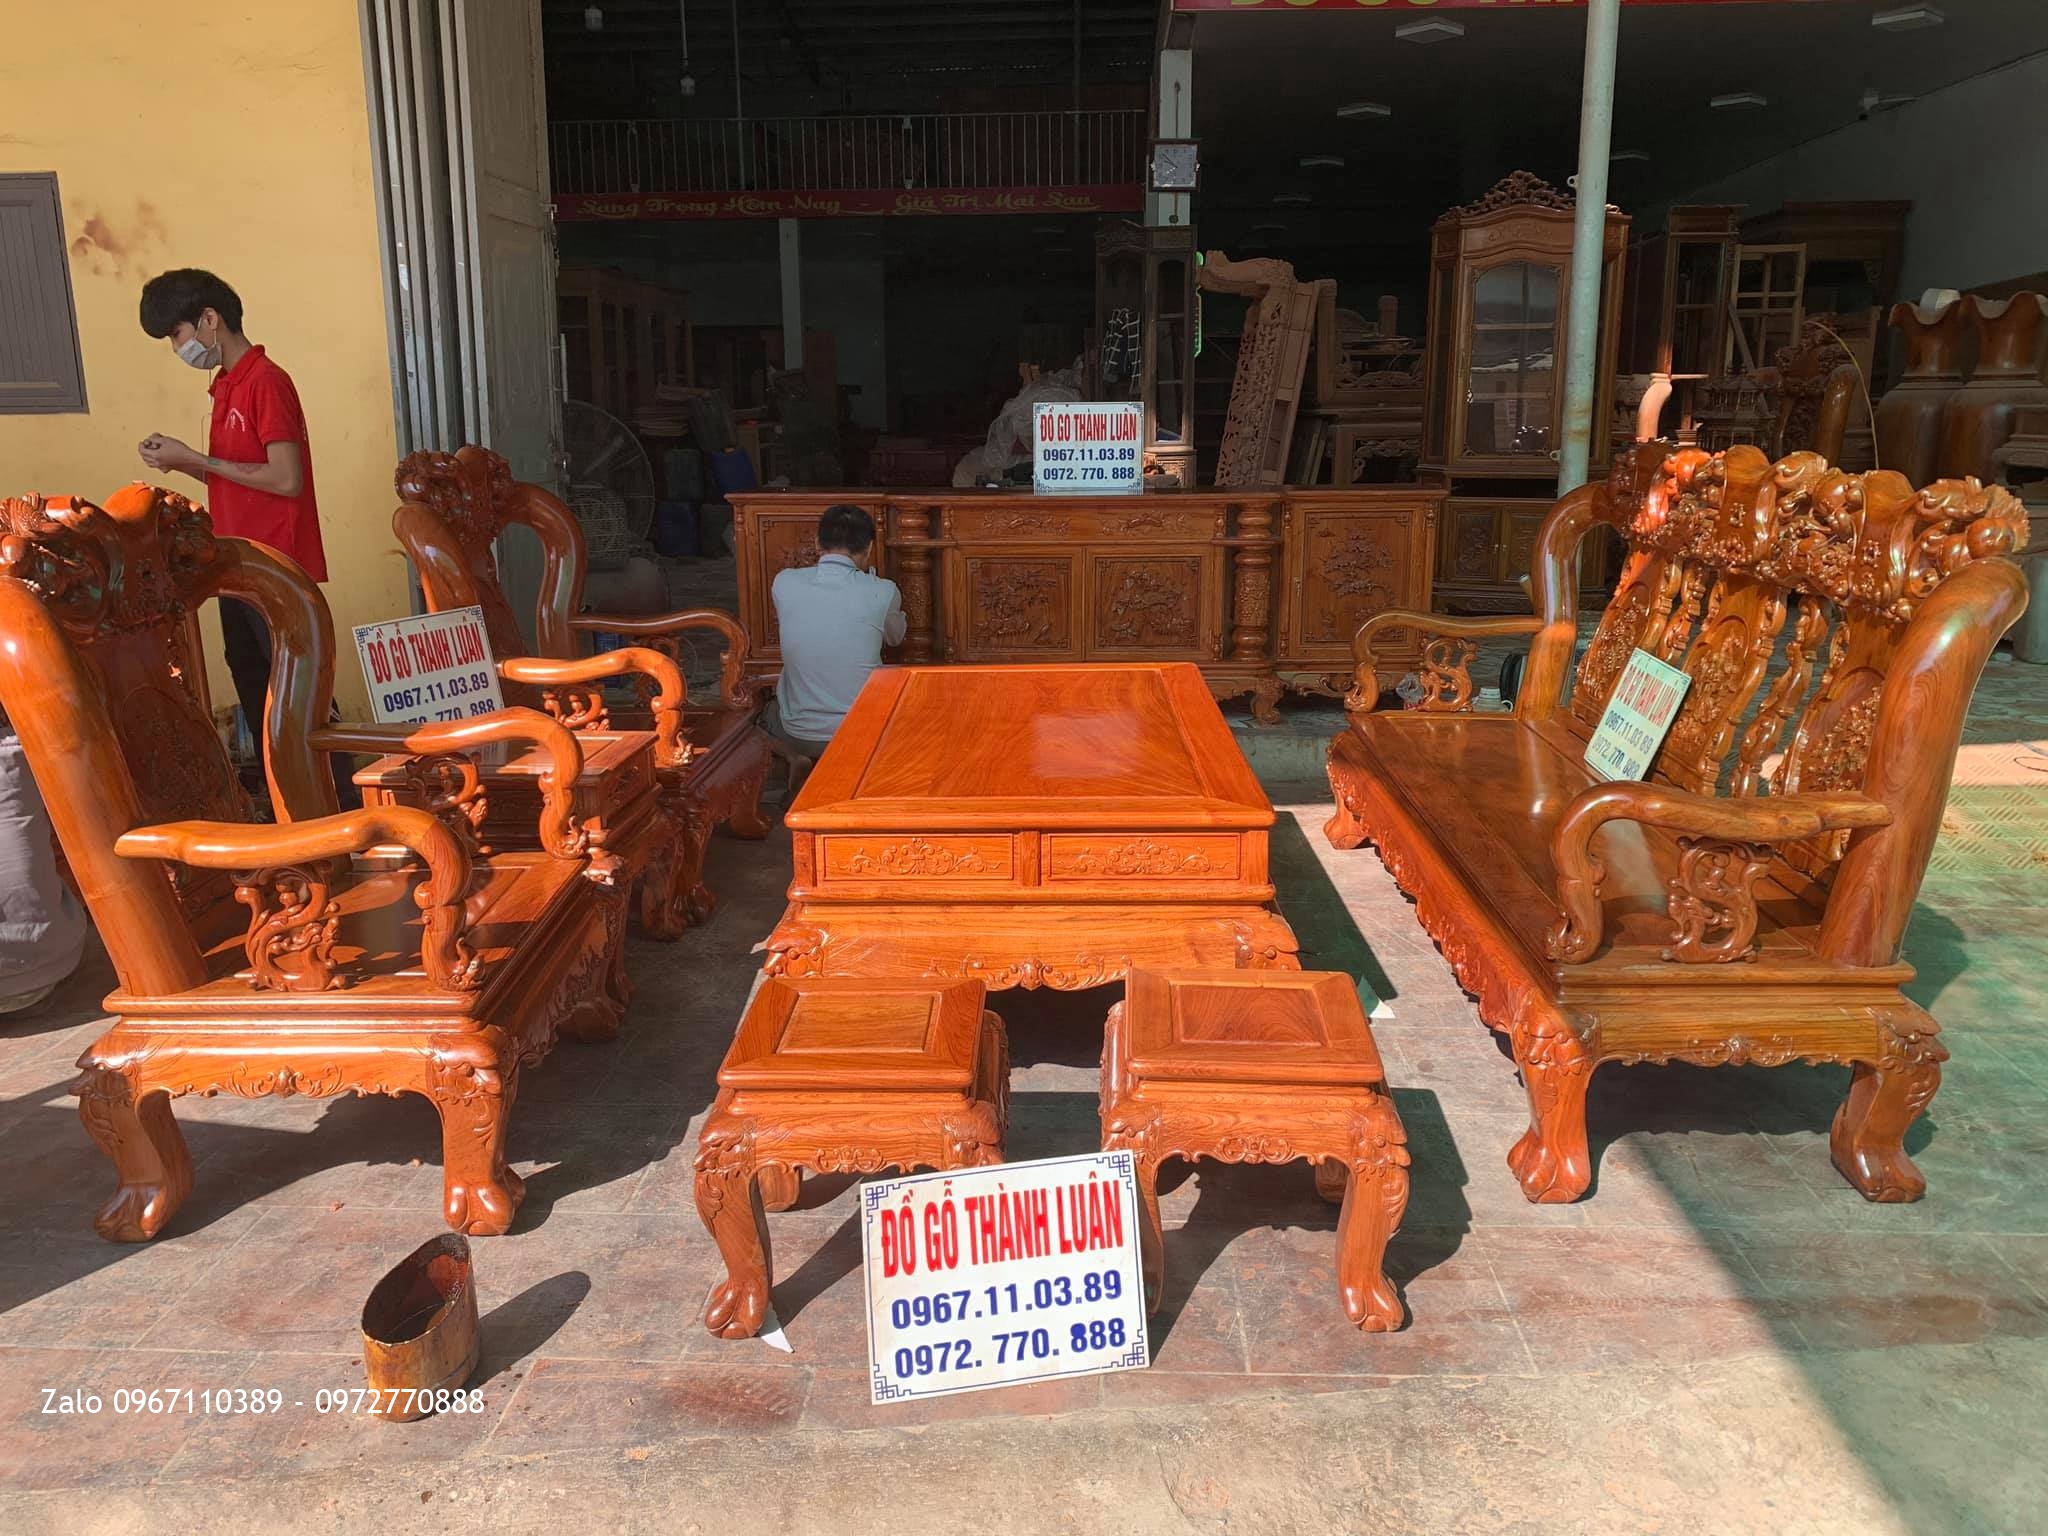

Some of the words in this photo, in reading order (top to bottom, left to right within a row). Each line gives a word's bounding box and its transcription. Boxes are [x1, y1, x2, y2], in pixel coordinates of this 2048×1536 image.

[576, 199, 639, 217] Sang
[986, 193, 1035, 209] Mai
[1043, 191, 1100, 211] Sau
[1074, 408, 1107, 441] THÀNH
[1110, 408, 1136, 441] LUÂN
[1043, 448, 1134, 461] 0967.11.03.89
[1043, 468, 1077, 480] 0972.
[1081, 468, 1107, 480] 770.
[1112, 467, 1134, 480] 888
[367, 628, 392, 684] ĐỒ
[389, 622, 412, 680] GỖ
[408, 624, 453, 675] THÀNH
[449, 616, 486, 666] LUÂN
[384, 672, 489, 712] 0967.11.03.89
[881, 1189, 916, 1278] ĐỒ
[923, 1180, 959, 1272] GỖ
[964, 1183, 1051, 1265] THÀNH
[1056, 1170, 1123, 1254] LUÂN
[891, 1269, 1122, 1329] 0967.11.03.89
[895, 1339, 982, 1378] 0972.
[992, 1328, 1059, 1365] 770.
[1070, 1317, 1126, 1353] 888
